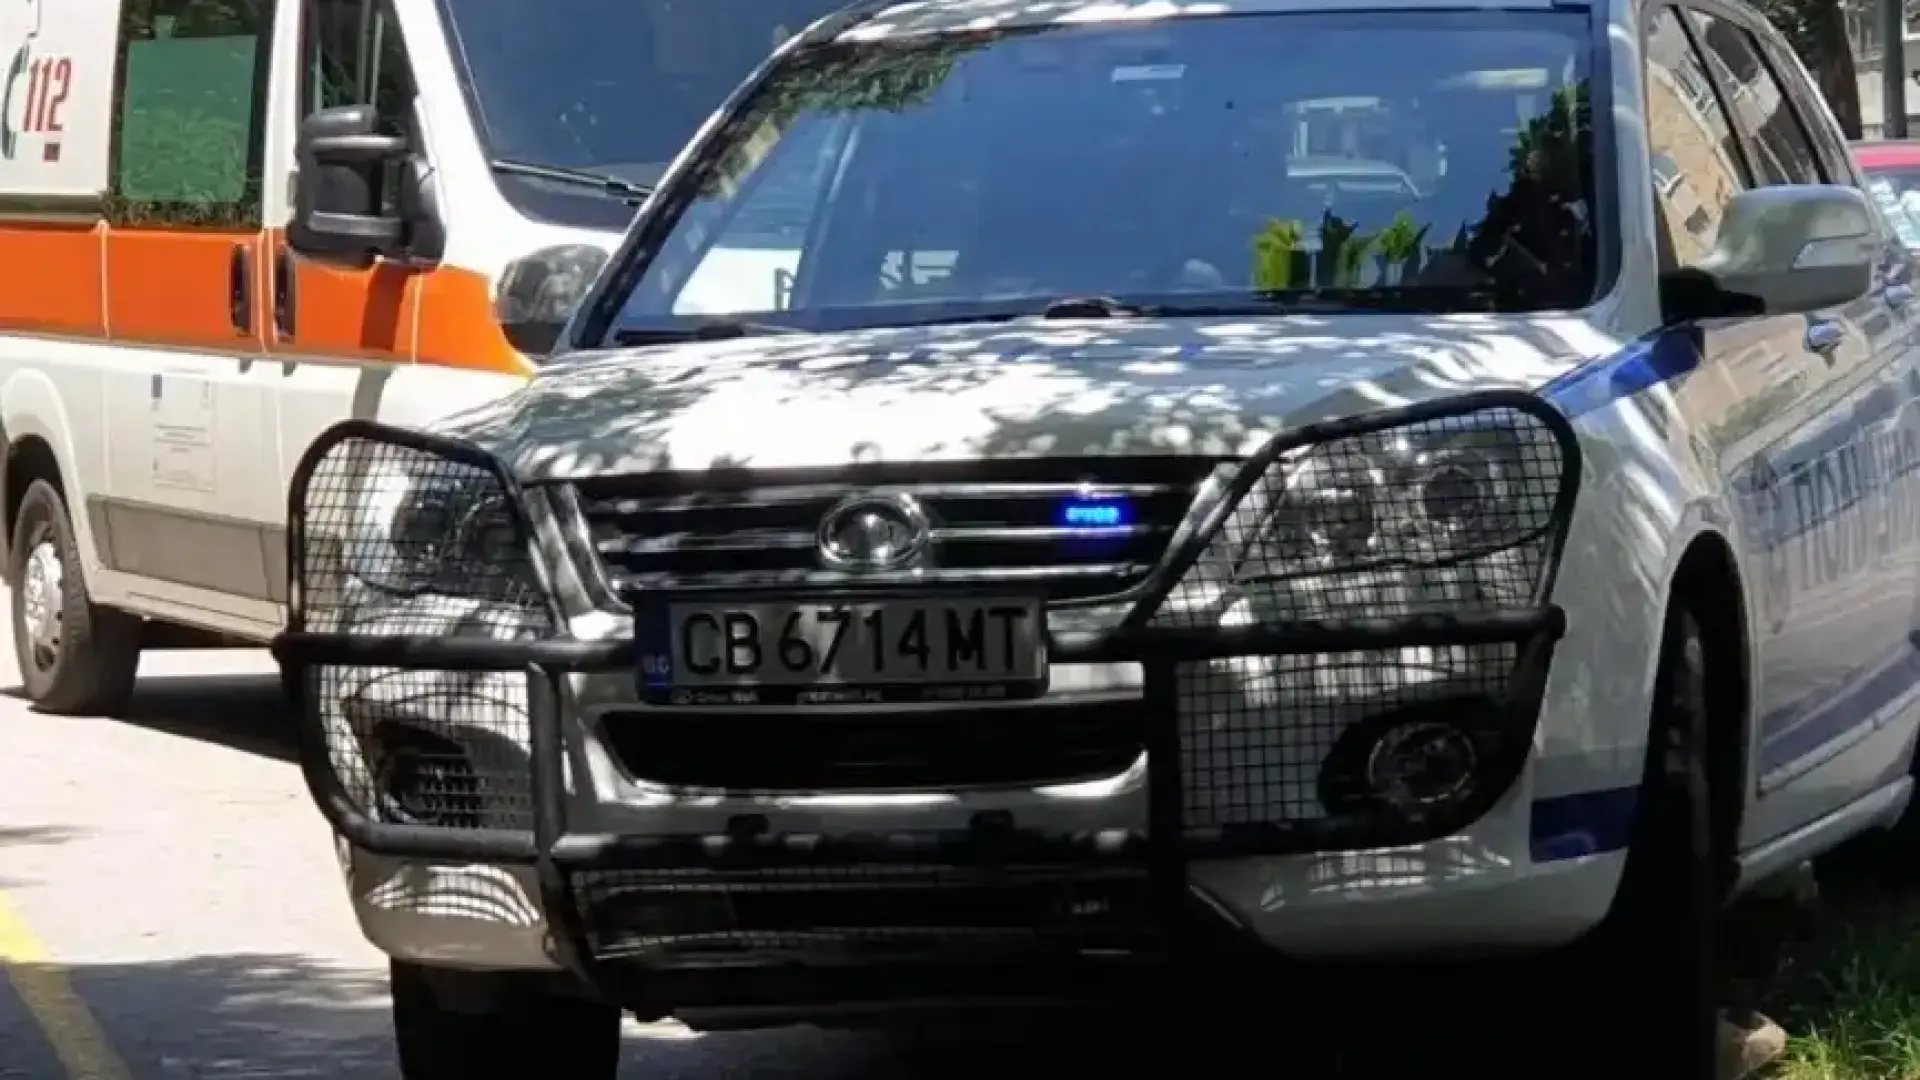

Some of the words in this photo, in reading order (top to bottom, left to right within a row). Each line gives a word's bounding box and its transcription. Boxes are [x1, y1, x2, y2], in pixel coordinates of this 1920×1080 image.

[23, 57, 72, 132] 112
[682, 610, 763, 676] CB
[779, 607, 931, 674] 6714
[945, 605, 1028, 673] MT
